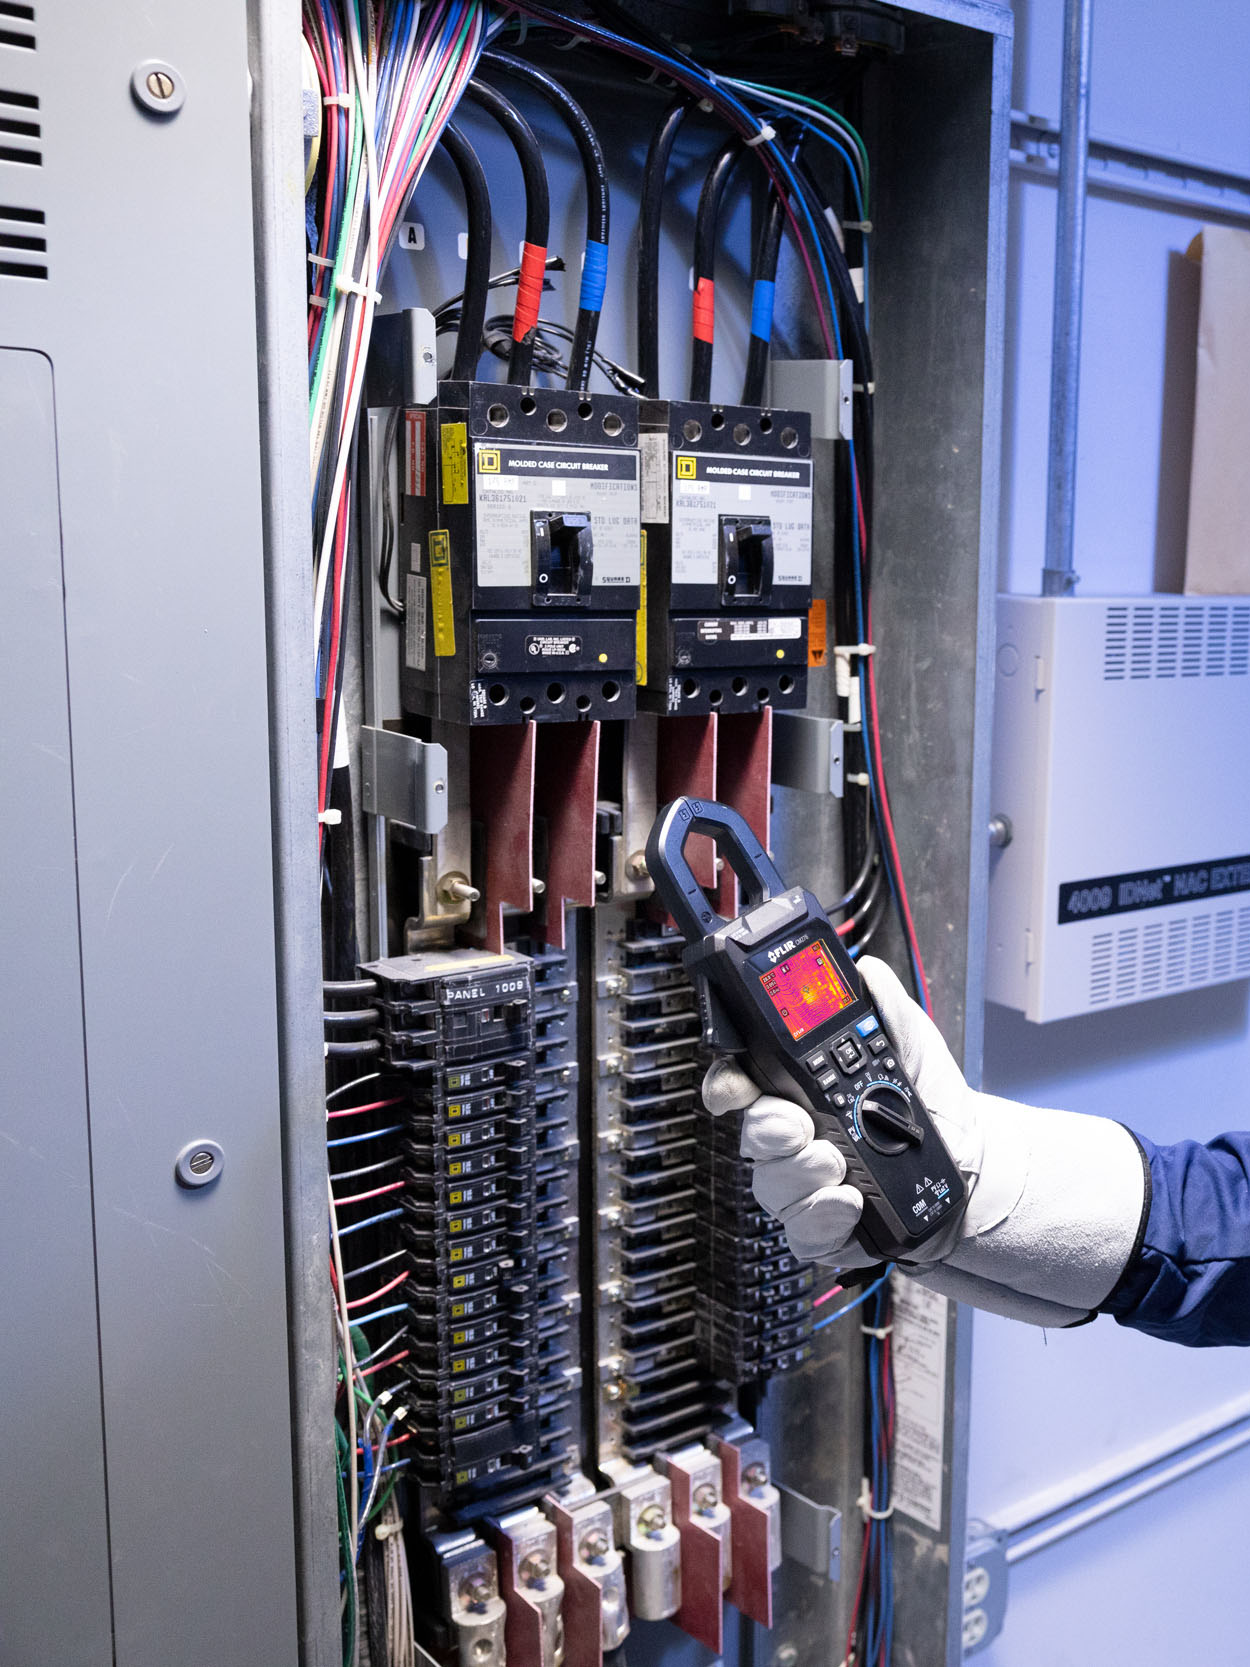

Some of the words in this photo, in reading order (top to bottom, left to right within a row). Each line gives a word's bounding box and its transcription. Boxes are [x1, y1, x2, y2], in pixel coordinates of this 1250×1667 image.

[407, 226, 417, 244] A
[508, 460, 537, 468] MOLDED
[537, 461, 555, 469] CASE
[555, 462, 581, 470] CIRCUIT
[581, 463, 608, 471] BREAKER
[706, 466, 733, 475] MOLDED
[733, 468, 749, 476] CASE
[749, 469, 773, 477] CIRCUIT
[773, 471, 800, 479] BREAKER
[590, 482, 638, 492] MODIFICATIONS
[773, 940, 797, 959] FLIR
[446, 988, 486, 1000] PANEL
[495, 980, 524, 993] 1009
[845, 1047, 854, 1056] OK
[853, 1080, 864, 1091] OFF
[912, 1199, 927, 1214] COM
